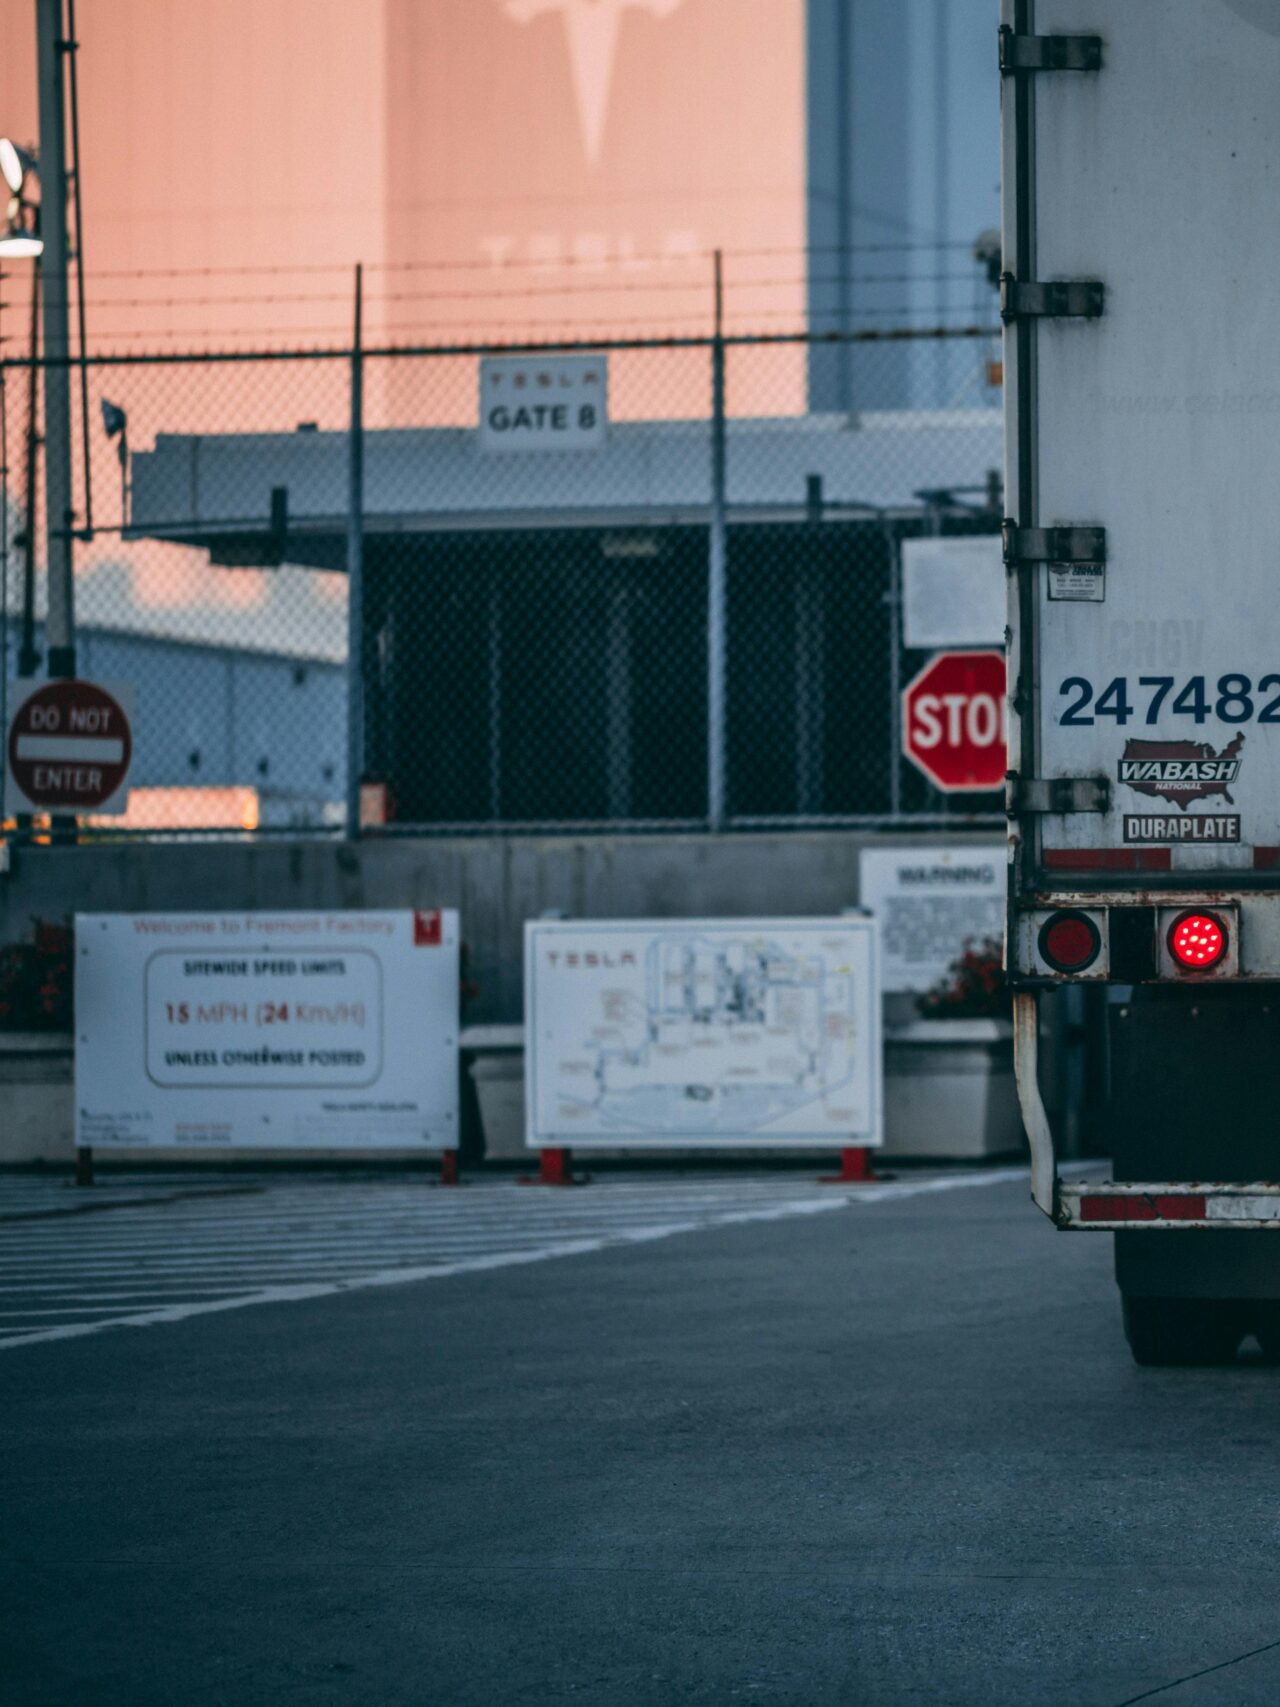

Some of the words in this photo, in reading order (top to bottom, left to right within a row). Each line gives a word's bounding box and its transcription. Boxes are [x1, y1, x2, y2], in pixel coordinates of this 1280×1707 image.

[490, 370, 598, 390] TESLA
[488, 404, 568, 432] GATE
[578, 403, 596, 431] 8
[30, 705, 59, 730] DO
[70, 707, 110, 732] NOT
[912, 694, 1006, 748] STO
[33, 766, 101, 791] ENTER
[1121, 762, 1237, 780] WABASH
[1127, 818, 1236, 839] DURAPLATE
[899, 865, 994, 884] WARNING
[133, 918, 214, 936] Welcome
[220, 918, 241, 935] to
[246, 916, 321, 935] Fremont
[326, 916, 395, 937] Factory
[184, 960, 248, 976] SITEWIDE
[253, 960, 296, 976] SPEED
[301, 960, 346, 975] LIMITS
[549, 951, 637, 969] TESLA
[165, 1002, 190, 1024] 15
[197, 1003, 248, 1024] MPH
[165, 1051, 217, 1067] UNLESS
[223, 1051, 304, 1067] OTHERWISE
[310, 1051, 365, 1067] POSTED
